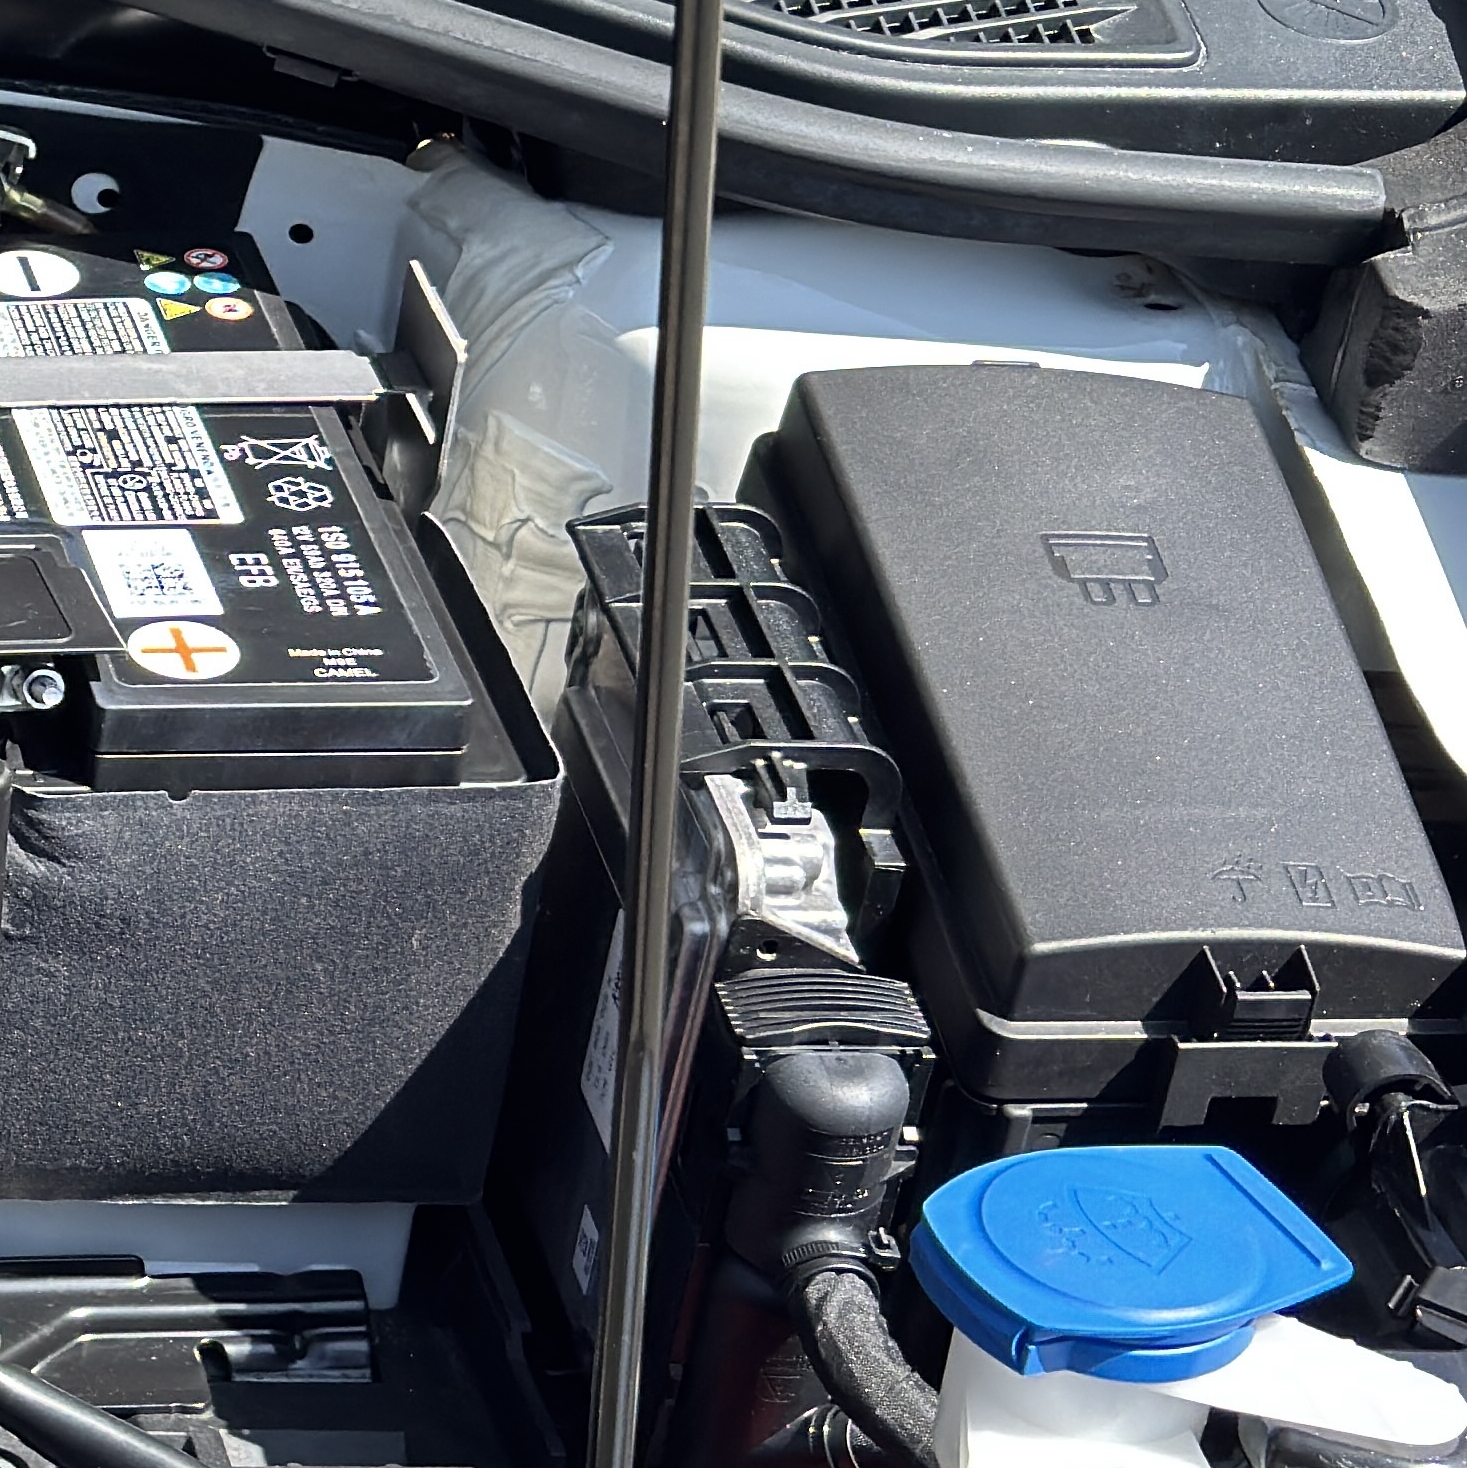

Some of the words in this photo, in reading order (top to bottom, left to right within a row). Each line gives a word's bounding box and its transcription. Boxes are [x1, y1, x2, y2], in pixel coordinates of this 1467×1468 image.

[228, 552, 280, 588] EFB
[330, 553, 365, 577] 915
[281, 558, 322, 614] EN/SAE/GS
[343, 579, 377, 603] 105
[354, 604, 384, 616] A
[288, 648, 326, 657] Made
[342, 647, 383, 656] China
[314, 667, 379, 678] CAMEL
